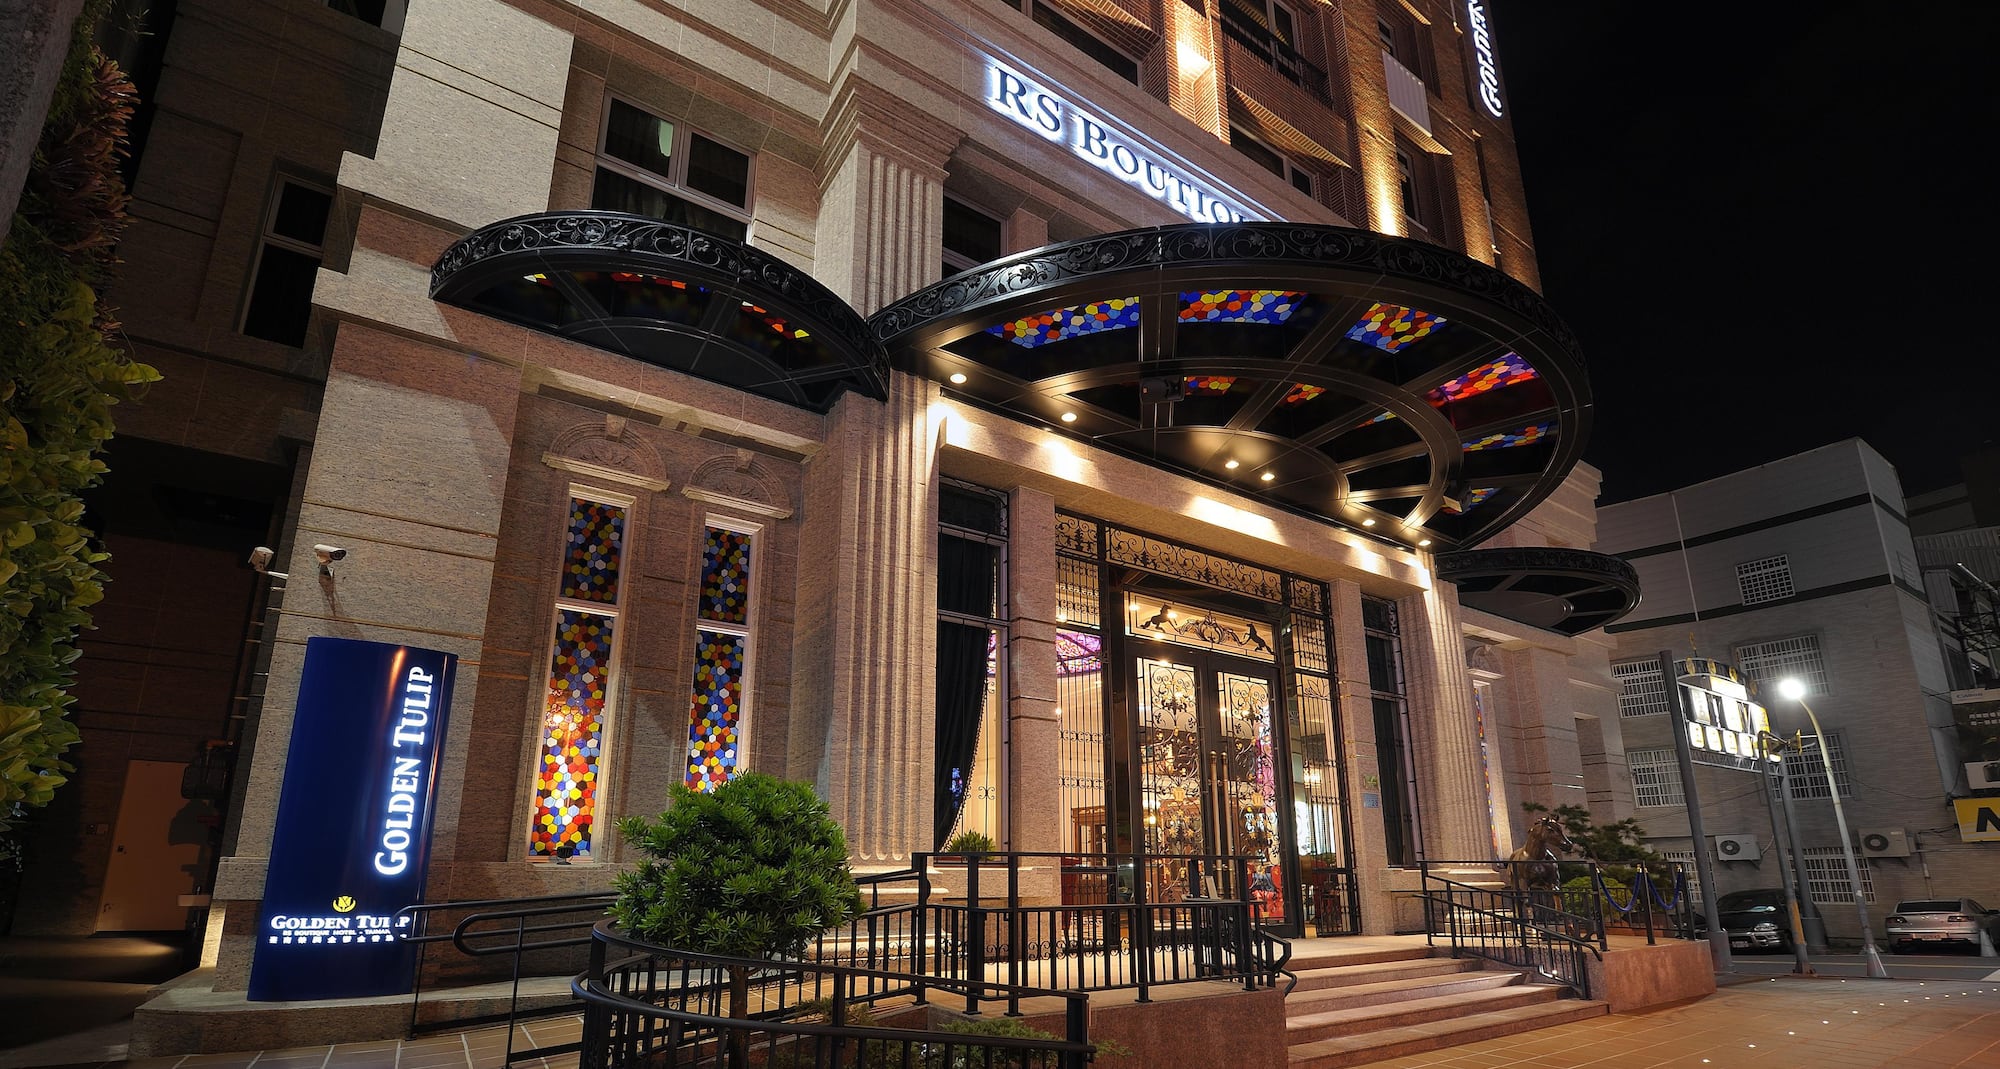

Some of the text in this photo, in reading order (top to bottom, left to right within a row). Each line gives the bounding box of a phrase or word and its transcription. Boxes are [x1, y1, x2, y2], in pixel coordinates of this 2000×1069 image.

[994, 65, 1245, 223] RS BOUTIQ
[375, 666, 434, 875] GOLDEN TULIP
[270, 915, 351, 929] GOLDEN
